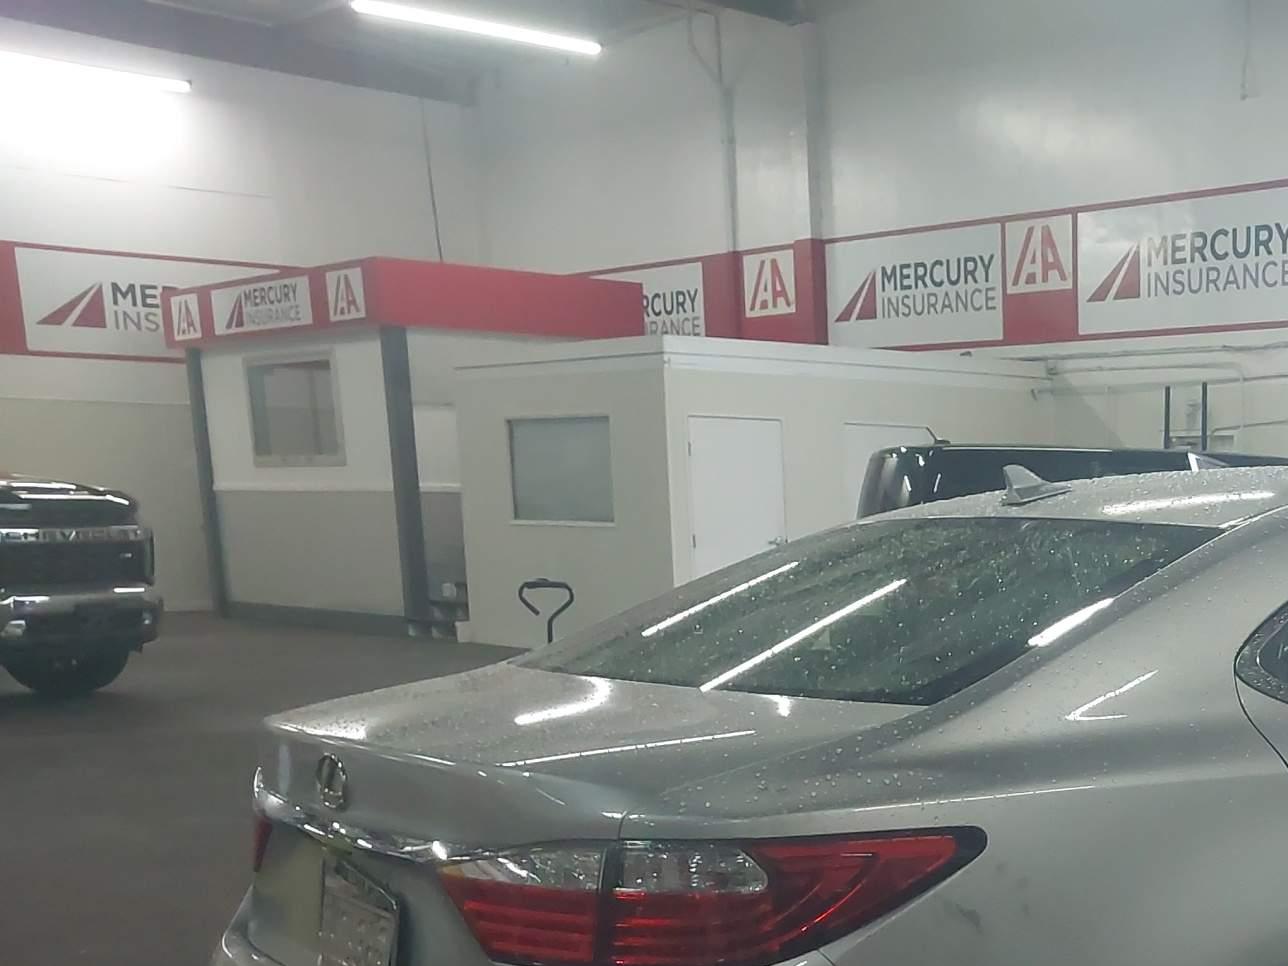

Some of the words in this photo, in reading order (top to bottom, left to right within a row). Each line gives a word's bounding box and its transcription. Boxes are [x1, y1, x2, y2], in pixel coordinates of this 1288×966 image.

[880, 253, 996, 293] MERCURY
[111, 282, 177, 309] ME
[243, 283, 298, 308] MERCURY
[881, 286, 997, 320] INSURANCE
[245, 305, 302, 327] INSURANCE
